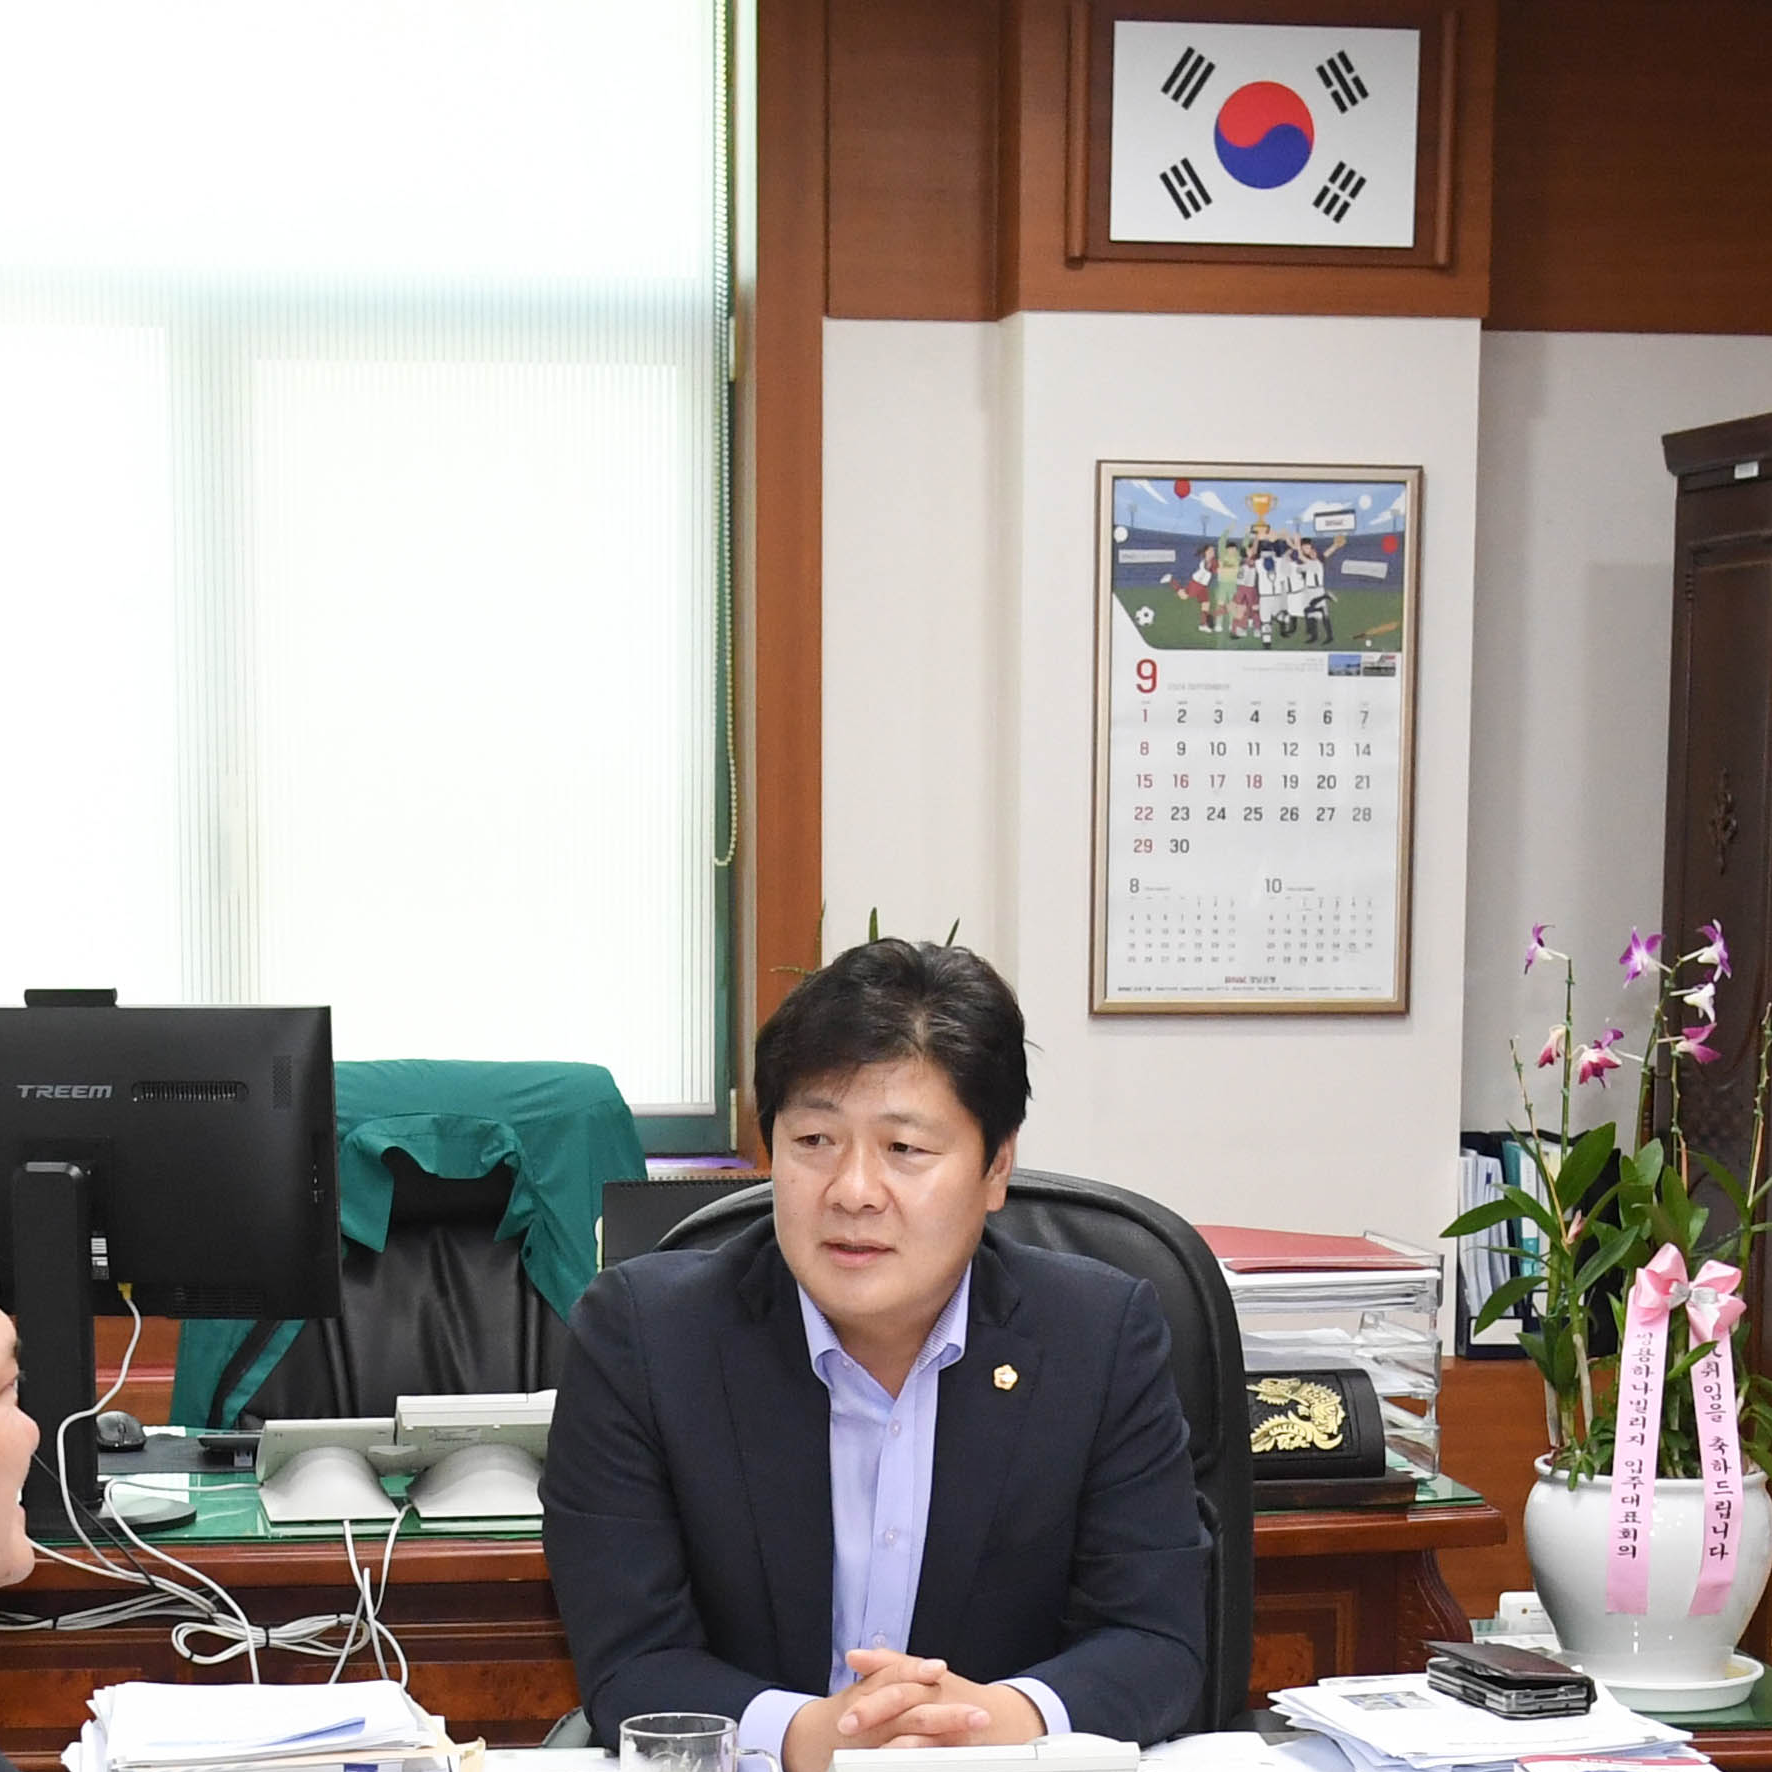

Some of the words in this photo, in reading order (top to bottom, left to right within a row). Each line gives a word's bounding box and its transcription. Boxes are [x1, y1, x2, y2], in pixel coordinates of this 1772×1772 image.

[1136, 658, 1157, 693] 9
[1142, 709, 1148, 724] 1
[1177, 709, 1187, 724] 2
[1213, 709, 1223, 724] 3
[1249, 709, 1260, 724] 4
[1287, 709, 1296, 724] 5
[1323, 709, 1333, 724] 6
[1359, 709, 1369, 724] 7
[1140, 742, 1150, 756] 8
[1176, 742, 1187, 756] 9
[1209, 742, 1227, 756] 10
[1247, 742, 1261, 756] 11
[1282, 742, 1299, 756] 12
[1318, 742, 1335, 756] 13
[1354, 742, 1372, 756] 14
[1136, 774, 1153, 789] 15
[1172, 774, 1189, 789] 16
[1209, 774, 1226, 789] 17
[1246, 774, 1263, 789] 18
[1282, 774, 1299, 789] 19
[1316, 774, 1337, 789] 20
[1354, 774, 1371, 789] 21
[1134, 806, 1154, 821] 22
[1170, 806, 1190, 821] 23
[1206, 806, 1227, 821] 24
[1243, 806, 1263, 821] 25
[1280, 806, 1300, 821] 26
[1316, 806, 1336, 821] 27
[1352, 806, 1372, 821] 28
[1133, 839, 1153, 854] 29
[1169, 839, 1190, 854] 30
[1129, 878, 1140, 893] 8
[1265, 878, 1282, 893] 10
[16, 1085, 112, 1099] TREEM
[1709, 1436, 1735, 1561] 축하드립니다
[1616, 1458, 1645, 1560] 입주대표회의
